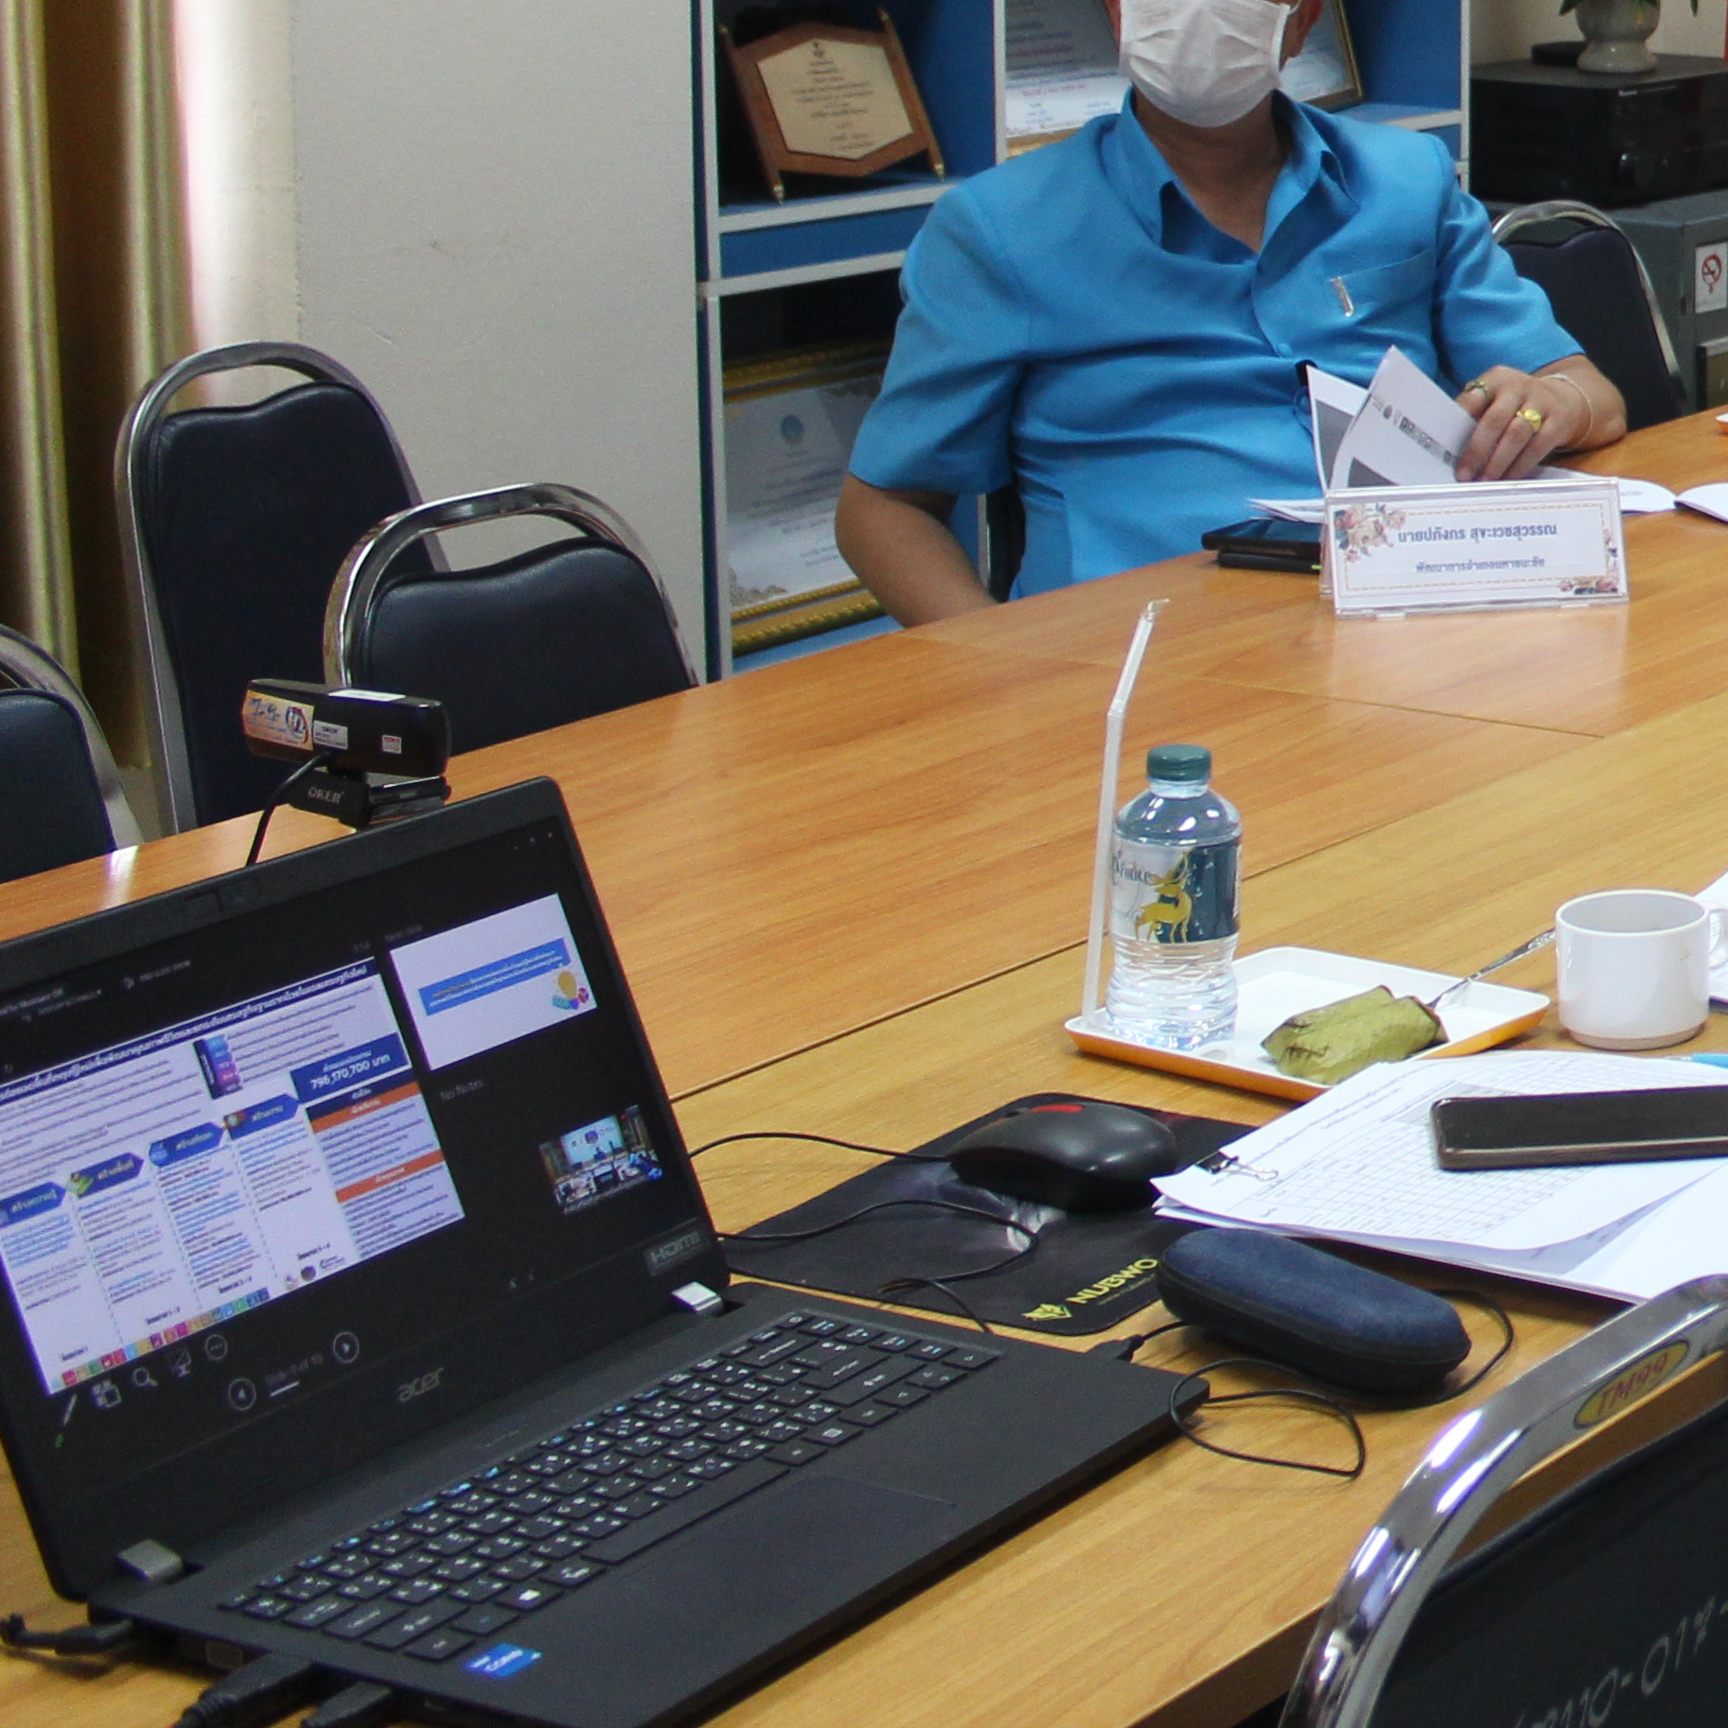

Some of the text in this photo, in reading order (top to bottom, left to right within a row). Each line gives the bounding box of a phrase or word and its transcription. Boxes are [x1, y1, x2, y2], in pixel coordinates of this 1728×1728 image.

[307, 786, 342, 805] OKER
[1065, 1257, 1159, 1305] NUBWO
[397, 1367, 445, 1404] acer
